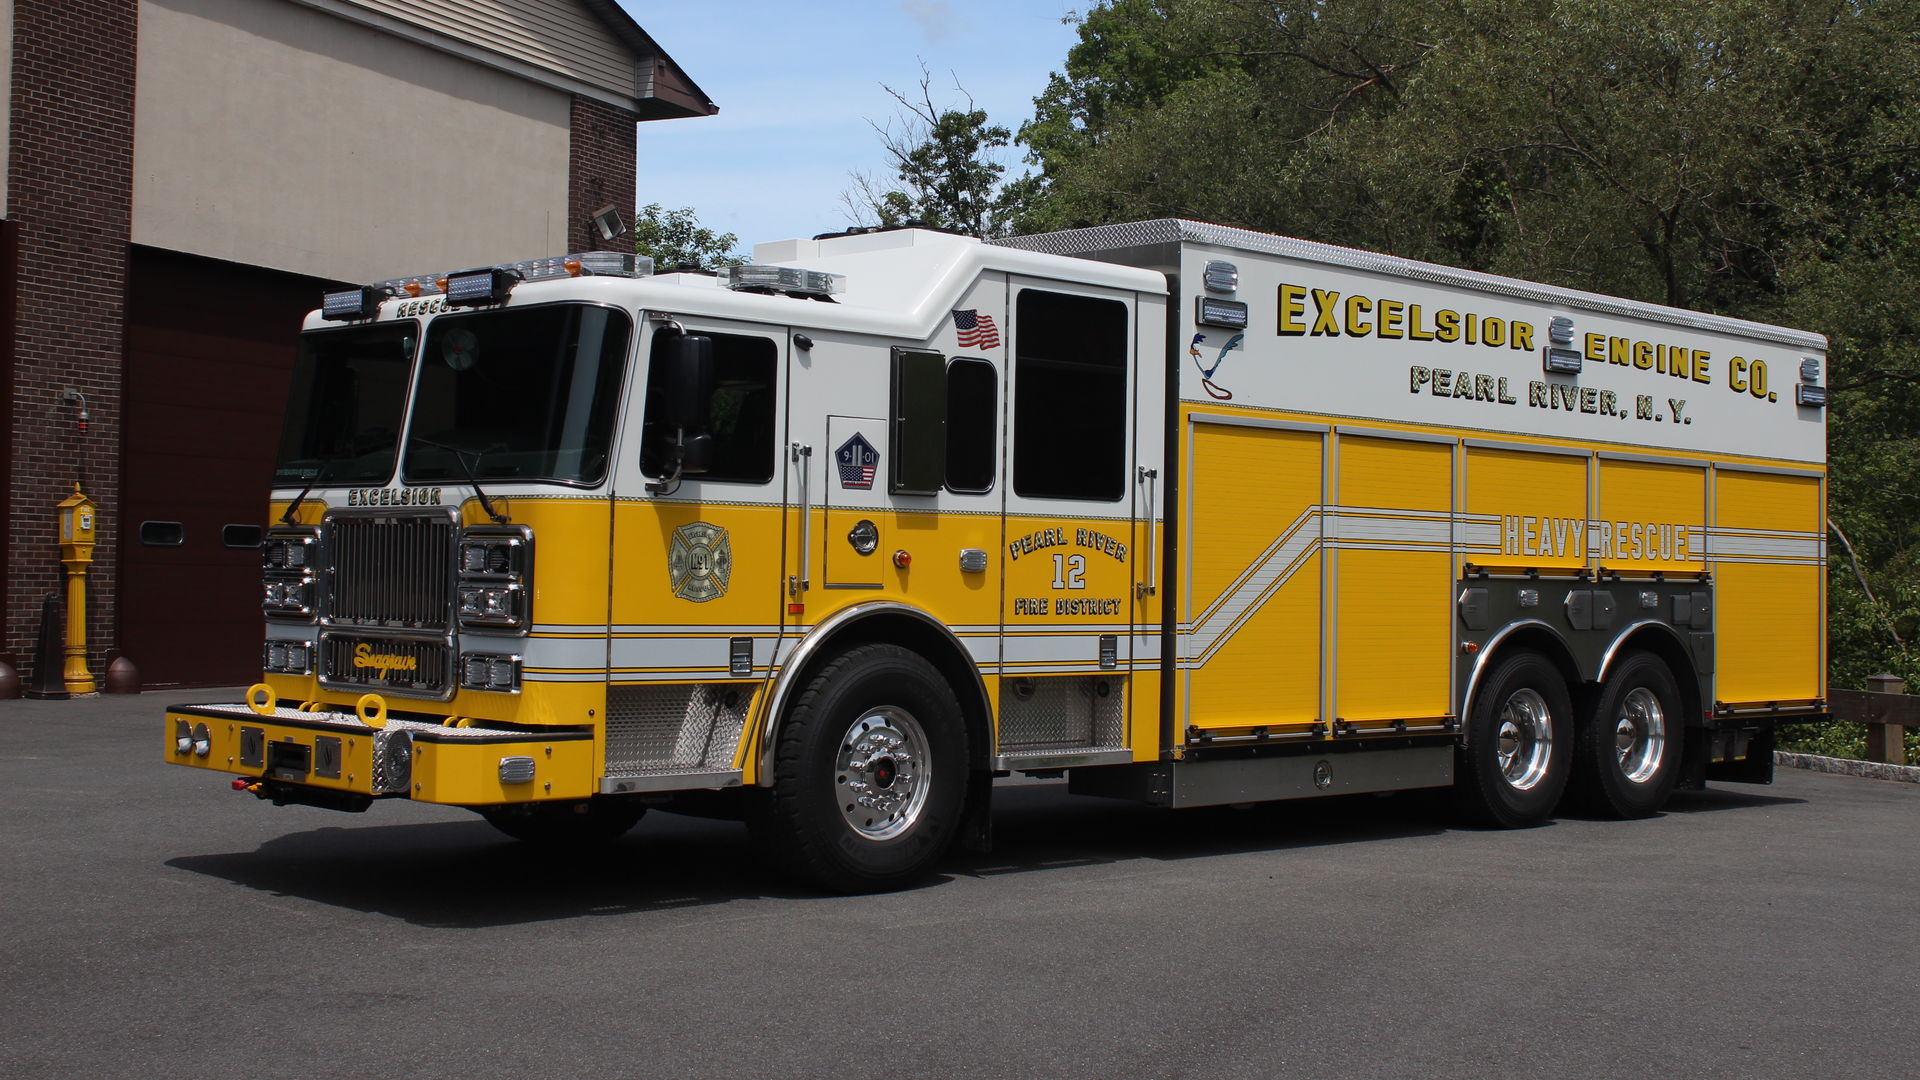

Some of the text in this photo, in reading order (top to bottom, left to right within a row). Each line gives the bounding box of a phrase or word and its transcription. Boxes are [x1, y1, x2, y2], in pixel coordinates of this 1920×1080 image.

[1277, 283, 1777, 403] EXCELSIOR ENGINE CO.
[1410, 365, 1516, 405] PEARL
[1529, 381, 1628, 420] RIVER,
[348, 487, 441, 506] EXCELSIOR
[1009, 527, 1128, 563] PEARL RIVER
[1505, 515, 1686, 560] HEAVY RESCUE
[1052, 554, 1085, 589] 12
[1015, 598, 1121, 615] FIRE DISTRICT
[354, 643, 417, 680] Seagrave
[840, 835, 921, 862] MICLIN
